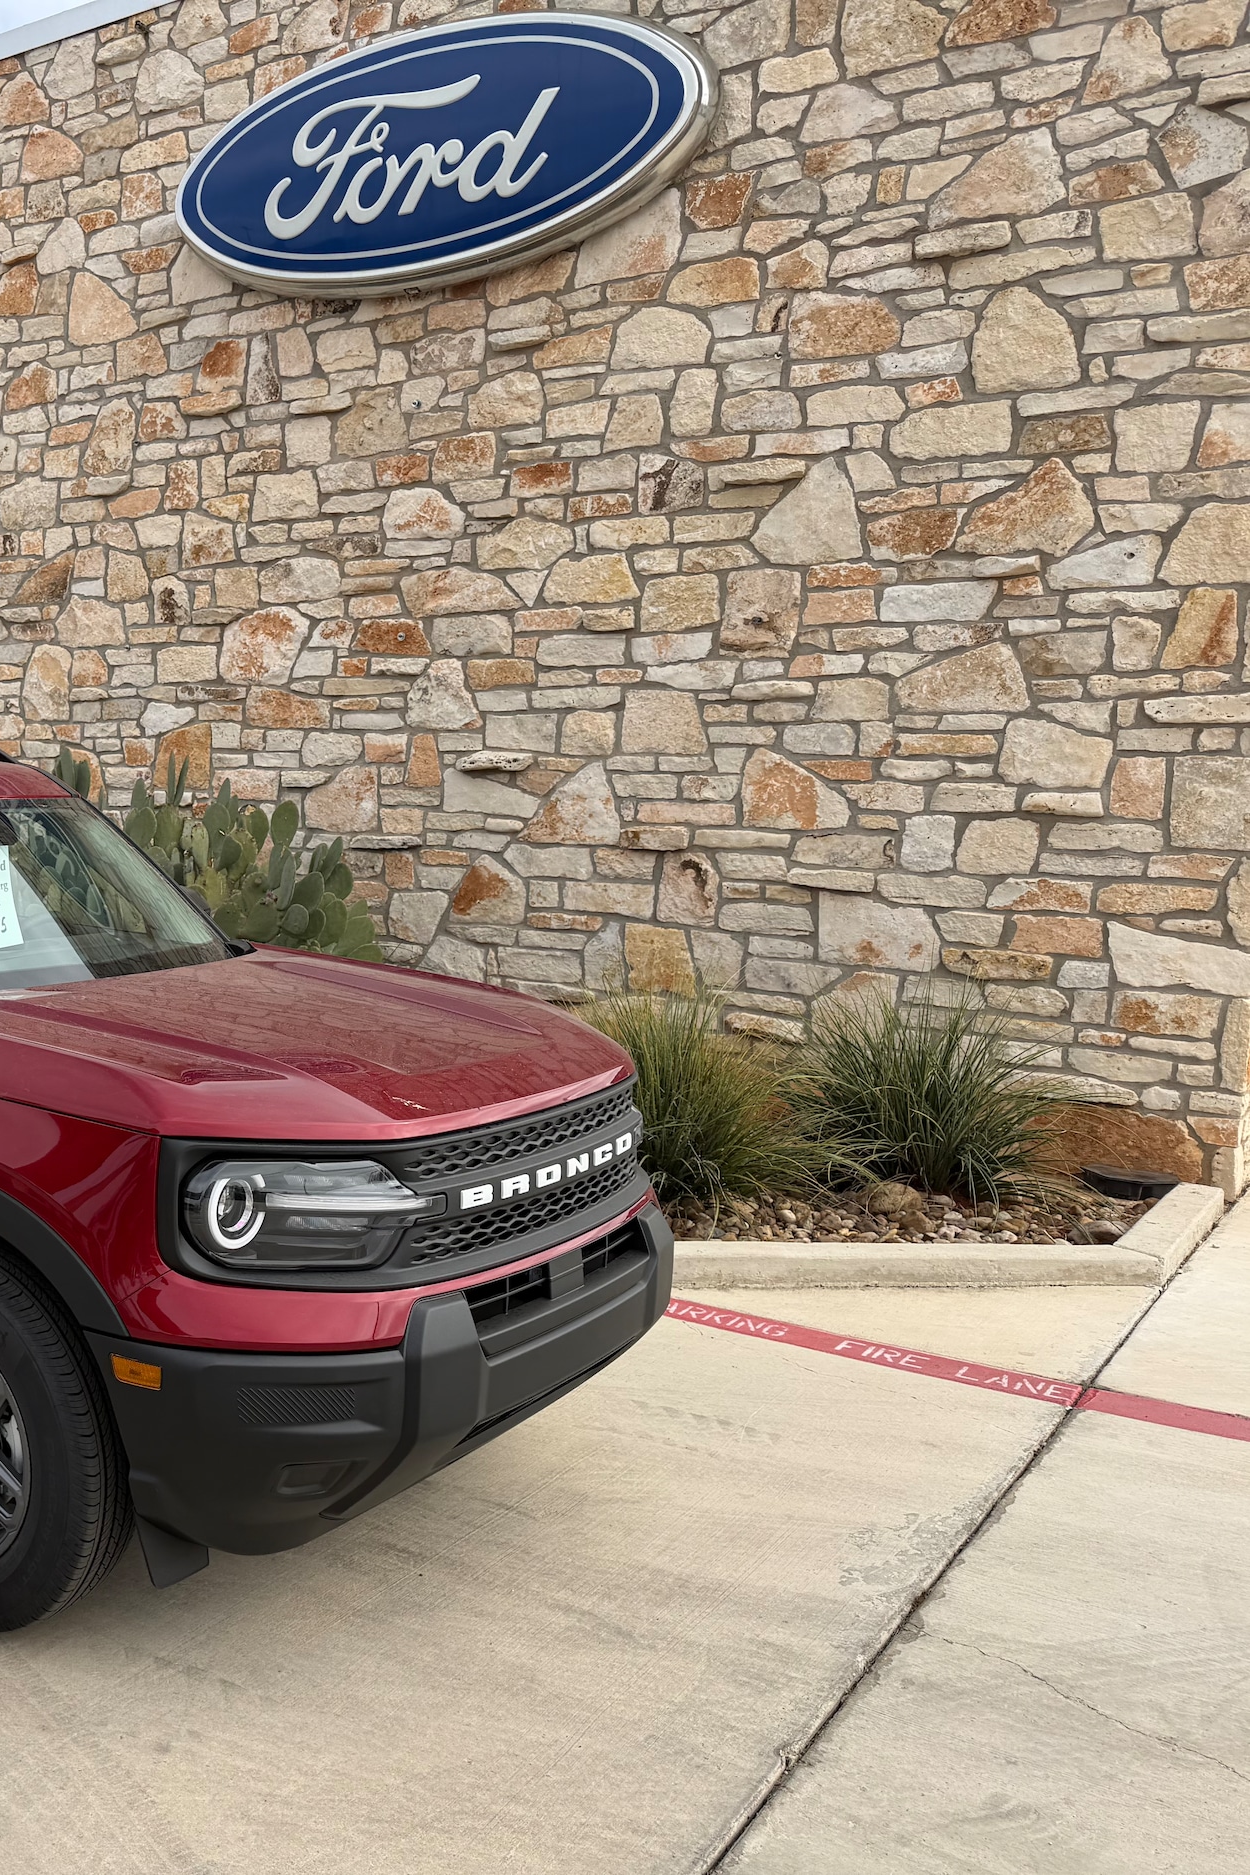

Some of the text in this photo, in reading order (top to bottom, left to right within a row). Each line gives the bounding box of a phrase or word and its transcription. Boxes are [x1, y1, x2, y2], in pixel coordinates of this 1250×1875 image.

[263, 73, 561, 241] Ford
[460, 1132, 633, 1210] BRONCO
[666, 1302, 1078, 1401] ARKING FIRE LANE
